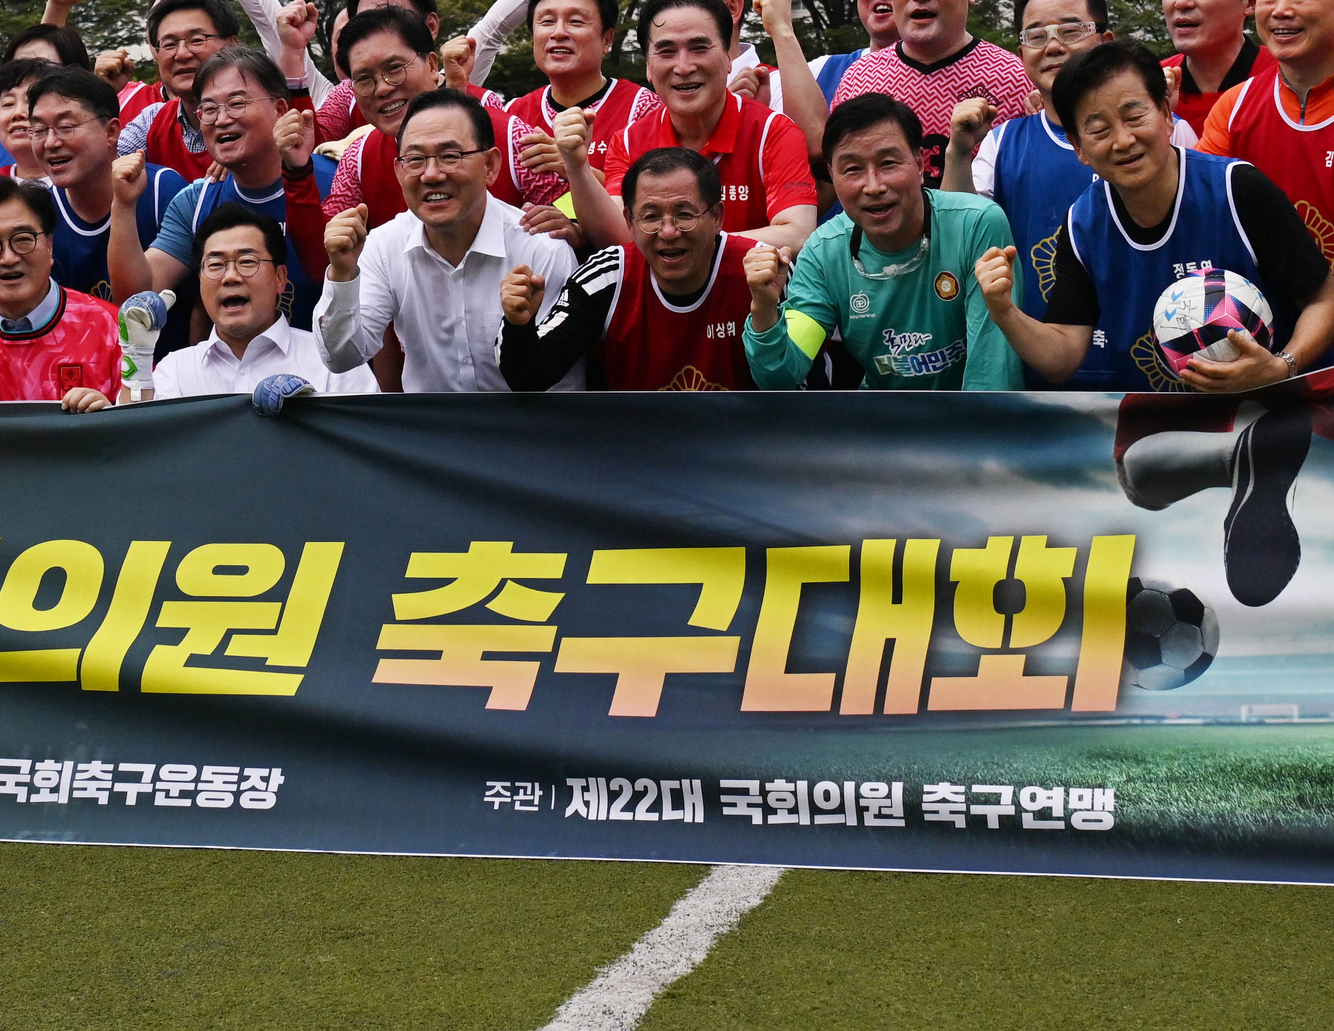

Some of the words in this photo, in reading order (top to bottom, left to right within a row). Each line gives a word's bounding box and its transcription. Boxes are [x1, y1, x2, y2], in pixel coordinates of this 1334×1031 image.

[706, 321, 736, 339] 이상휘
[371, 534, 1137, 718] 축구대회
[482, 780, 545, 812] 주관
[565, 777, 705, 824] 제22대
[719, 778, 907, 828] 국회의원
[921, 784, 1116, 831] 축구연맹
